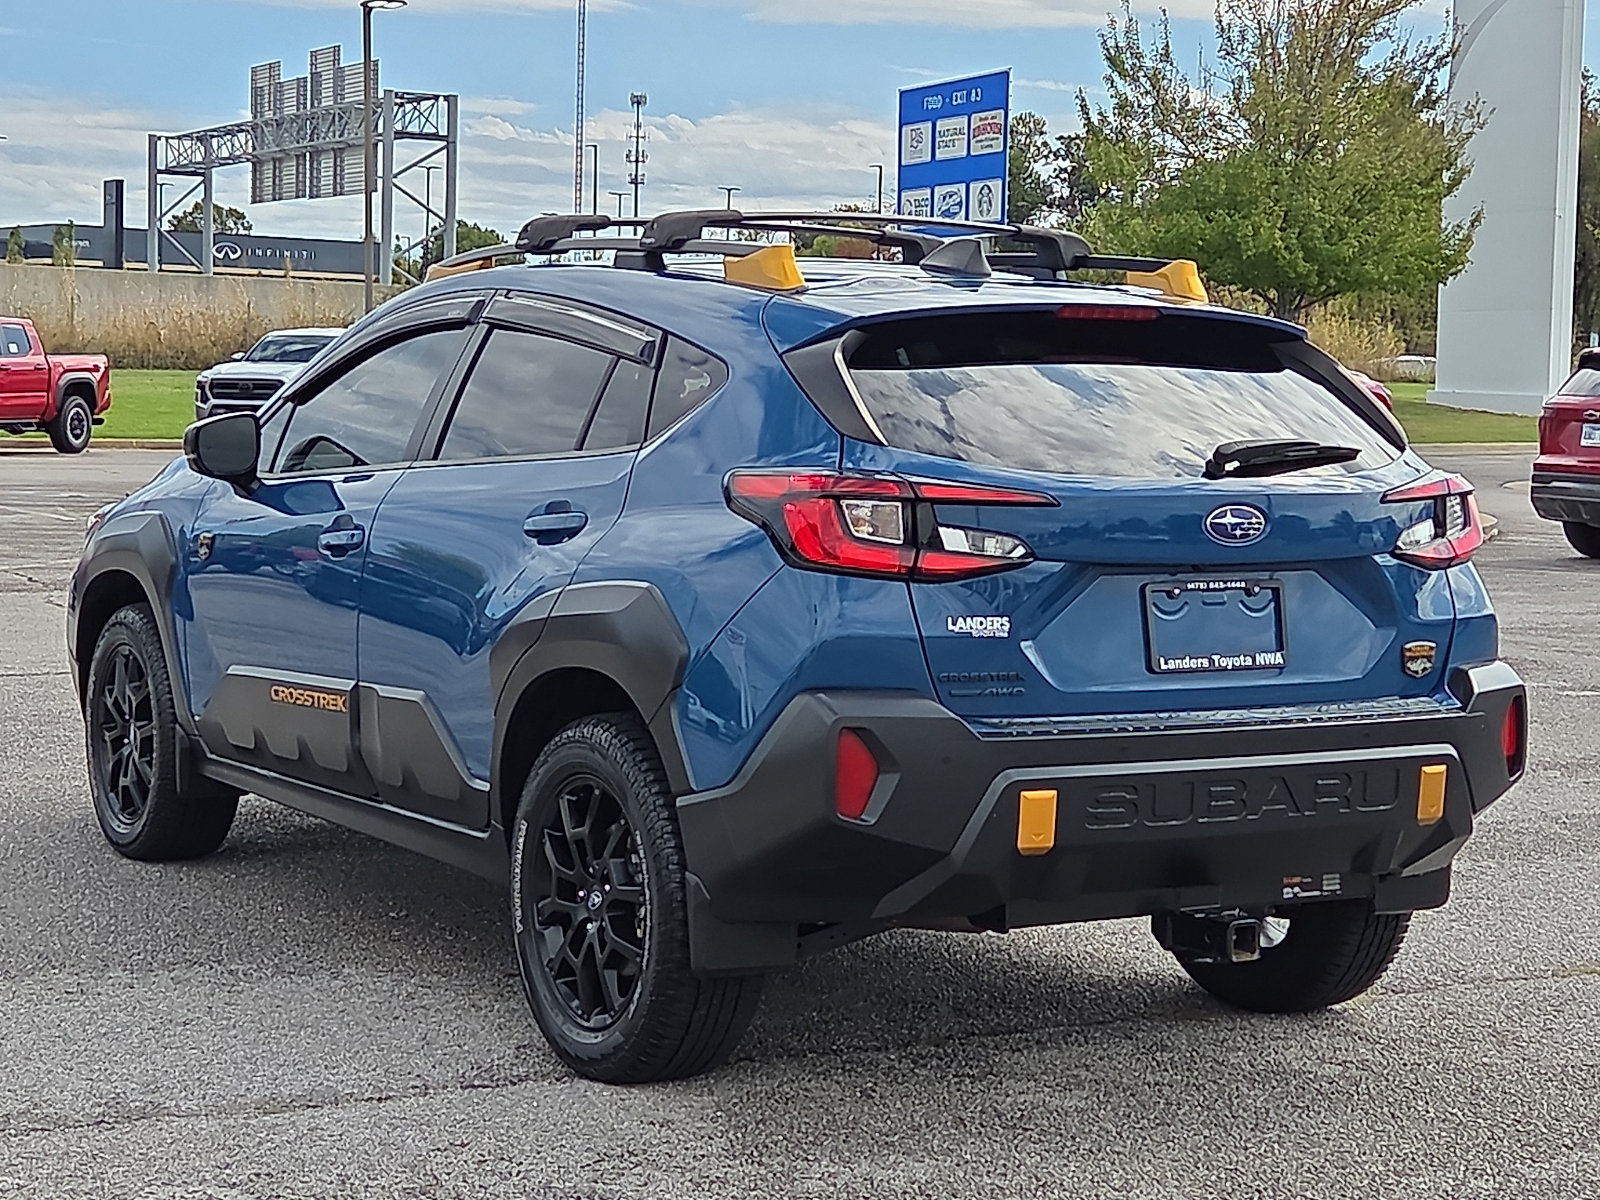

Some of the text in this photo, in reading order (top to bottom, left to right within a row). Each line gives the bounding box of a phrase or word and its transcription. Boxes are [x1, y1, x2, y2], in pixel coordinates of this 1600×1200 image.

[952, 90, 967, 105] EXIT
[970, 88, 982, 102] 83
[937, 127, 966, 138] NATURAL
[937, 138, 957, 150] STATE
[247, 248, 316, 260] INFINITI
[947, 616, 1011, 631] LANDERS
[1160, 652, 1284, 670] Landers Toyota NWA
[938, 671, 1026, 683] CROSSTREK
[270, 685, 347, 713] CROSSTREK
[1084, 767, 1401, 831] SUBARU
